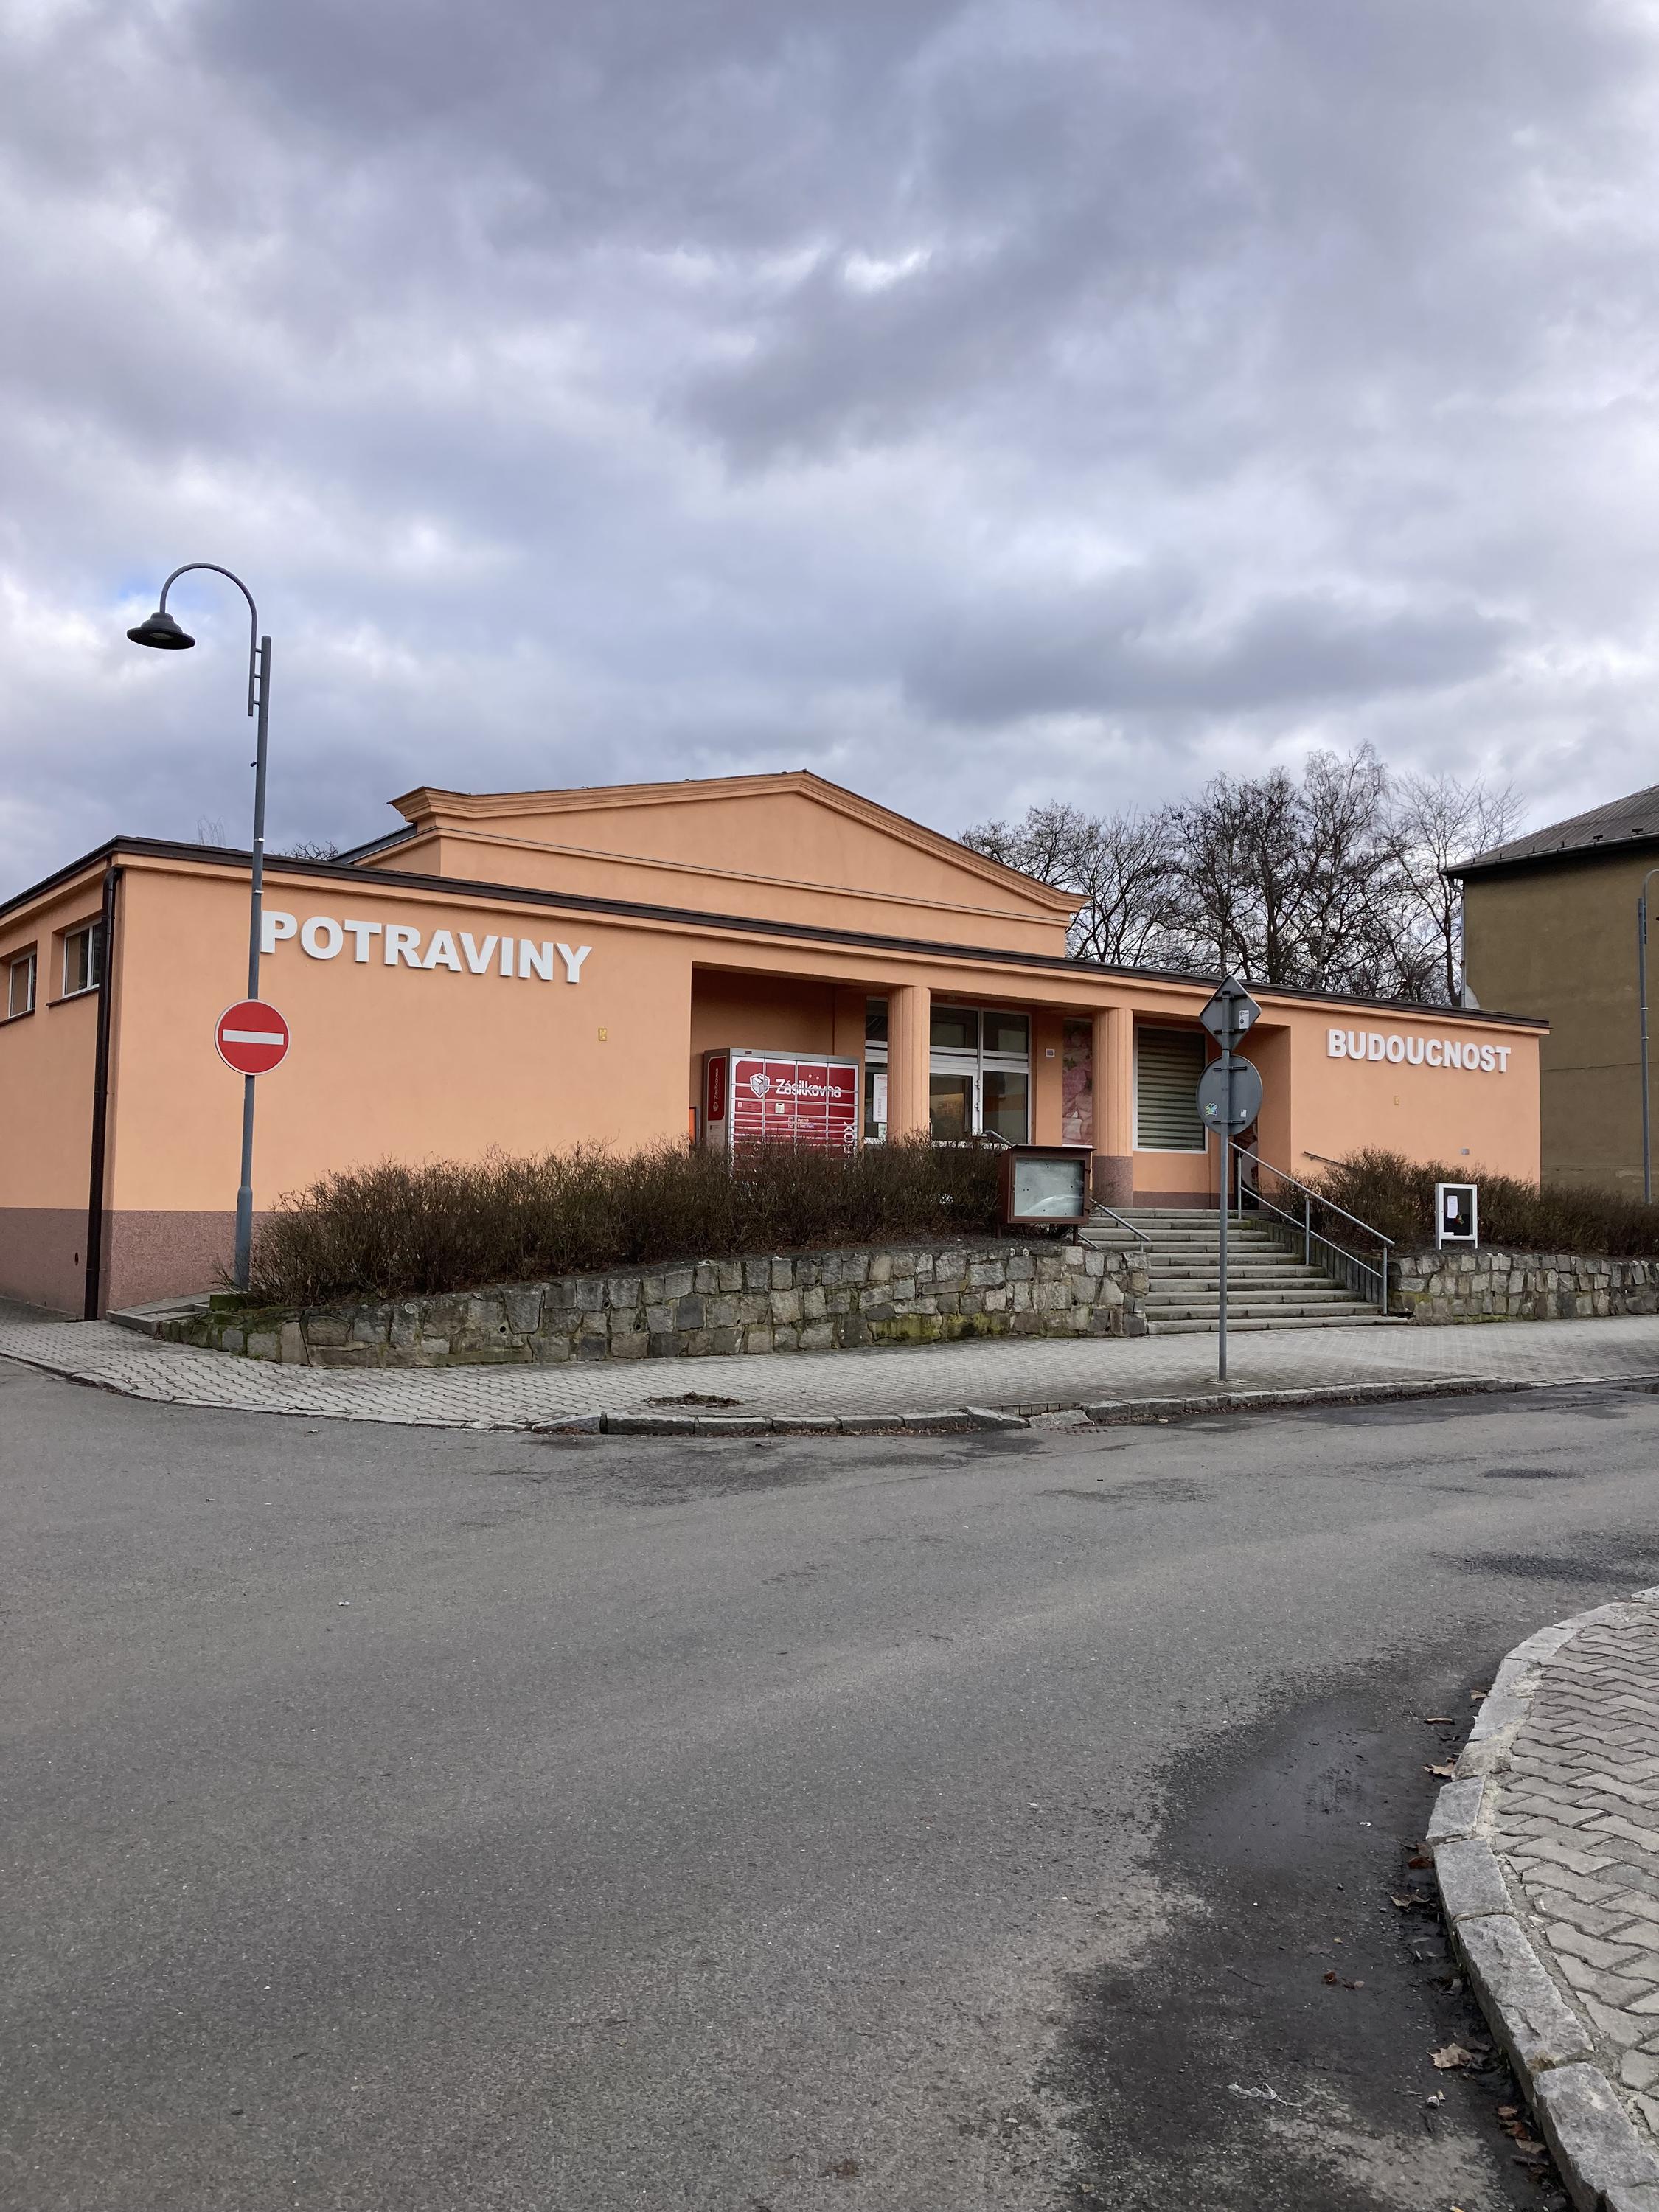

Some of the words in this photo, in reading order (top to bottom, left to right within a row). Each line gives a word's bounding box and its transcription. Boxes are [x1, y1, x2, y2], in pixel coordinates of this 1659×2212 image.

[260, 910, 593, 983] POTRAVINY
[1327, 1029, 1512, 1073] BUDOUCNOST
[775, 1078, 841, 1098] Zásilkovna
